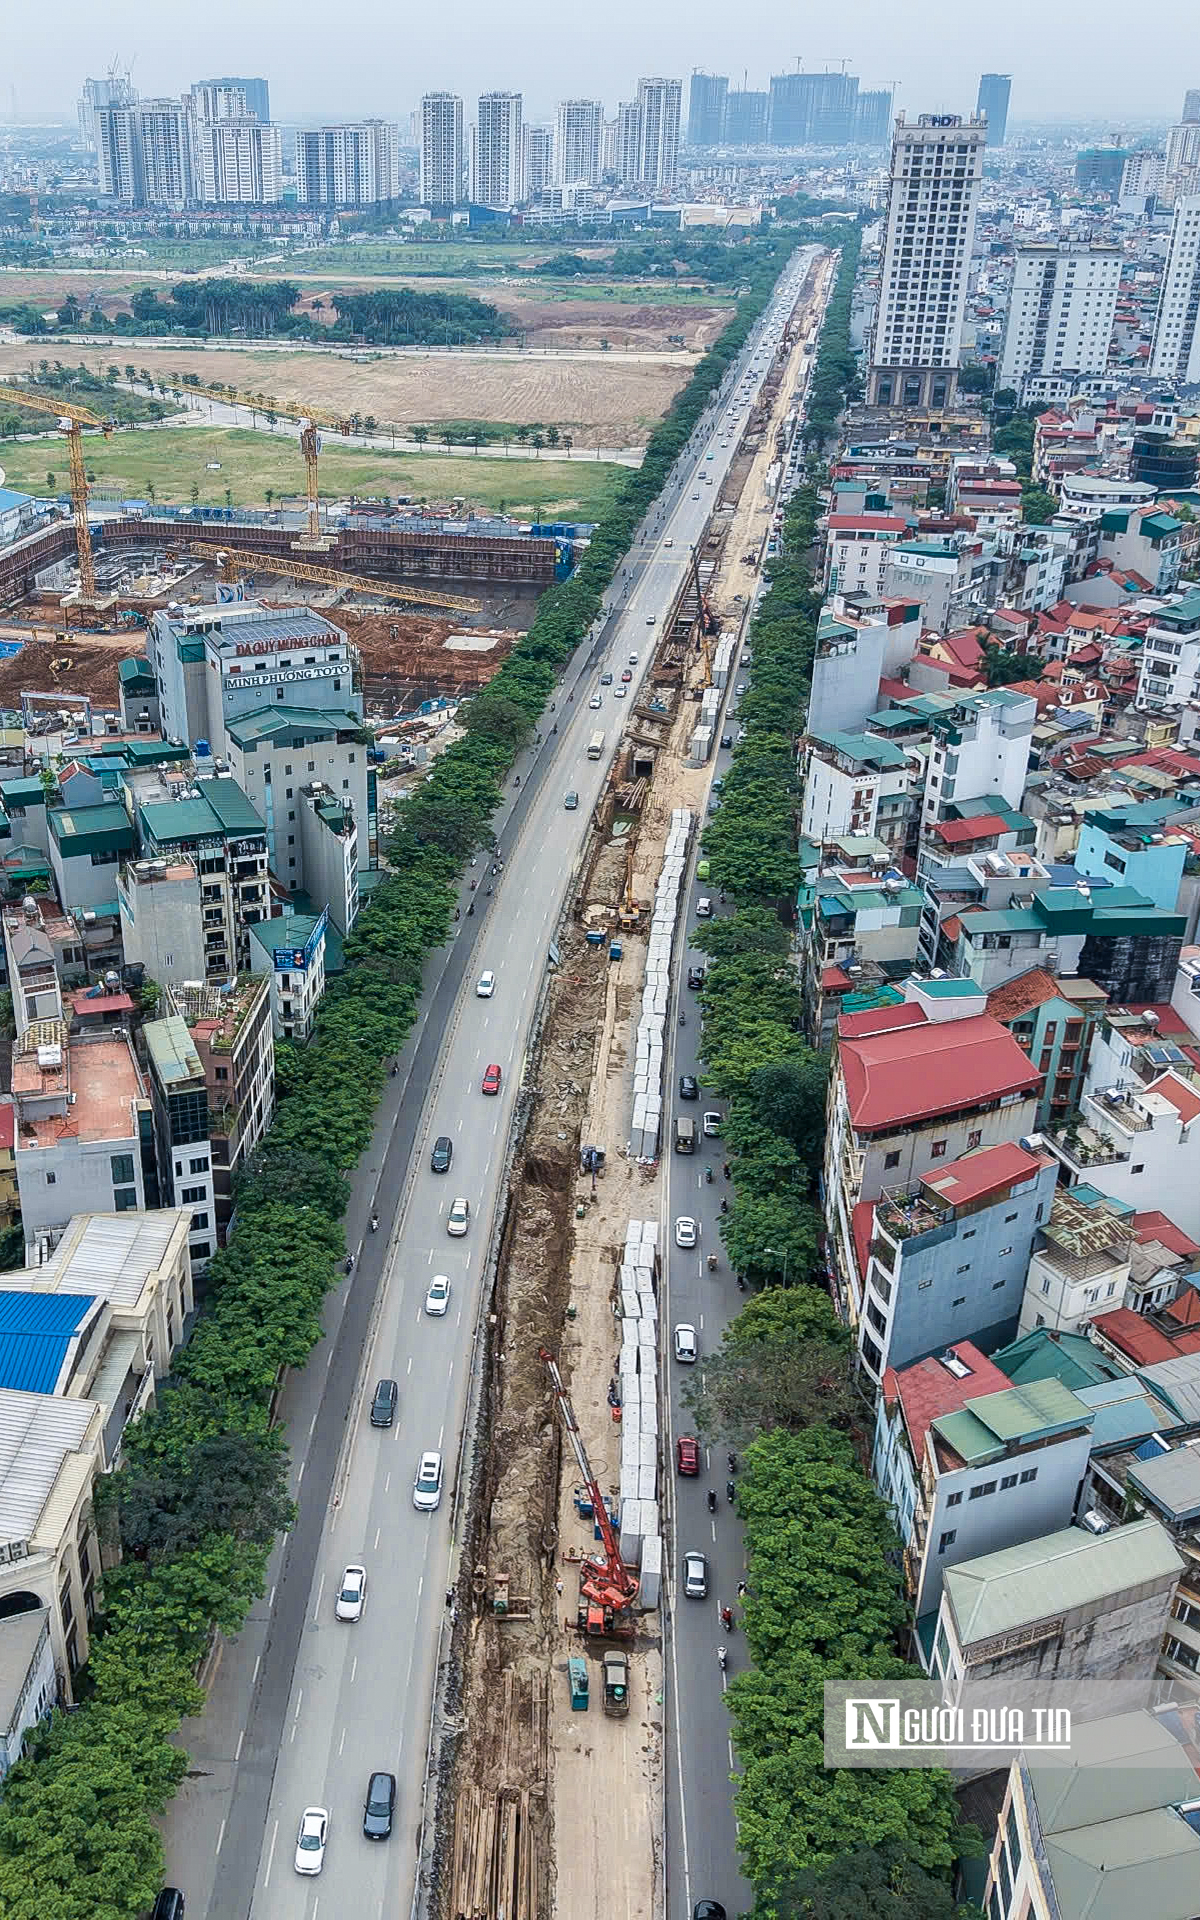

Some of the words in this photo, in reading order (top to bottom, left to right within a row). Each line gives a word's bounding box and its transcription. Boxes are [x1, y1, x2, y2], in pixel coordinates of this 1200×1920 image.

[227, 676, 260, 688] MINH
[261, 670, 312, 684] PHƯƠNG
[314, 665, 350, 677] TOTO
